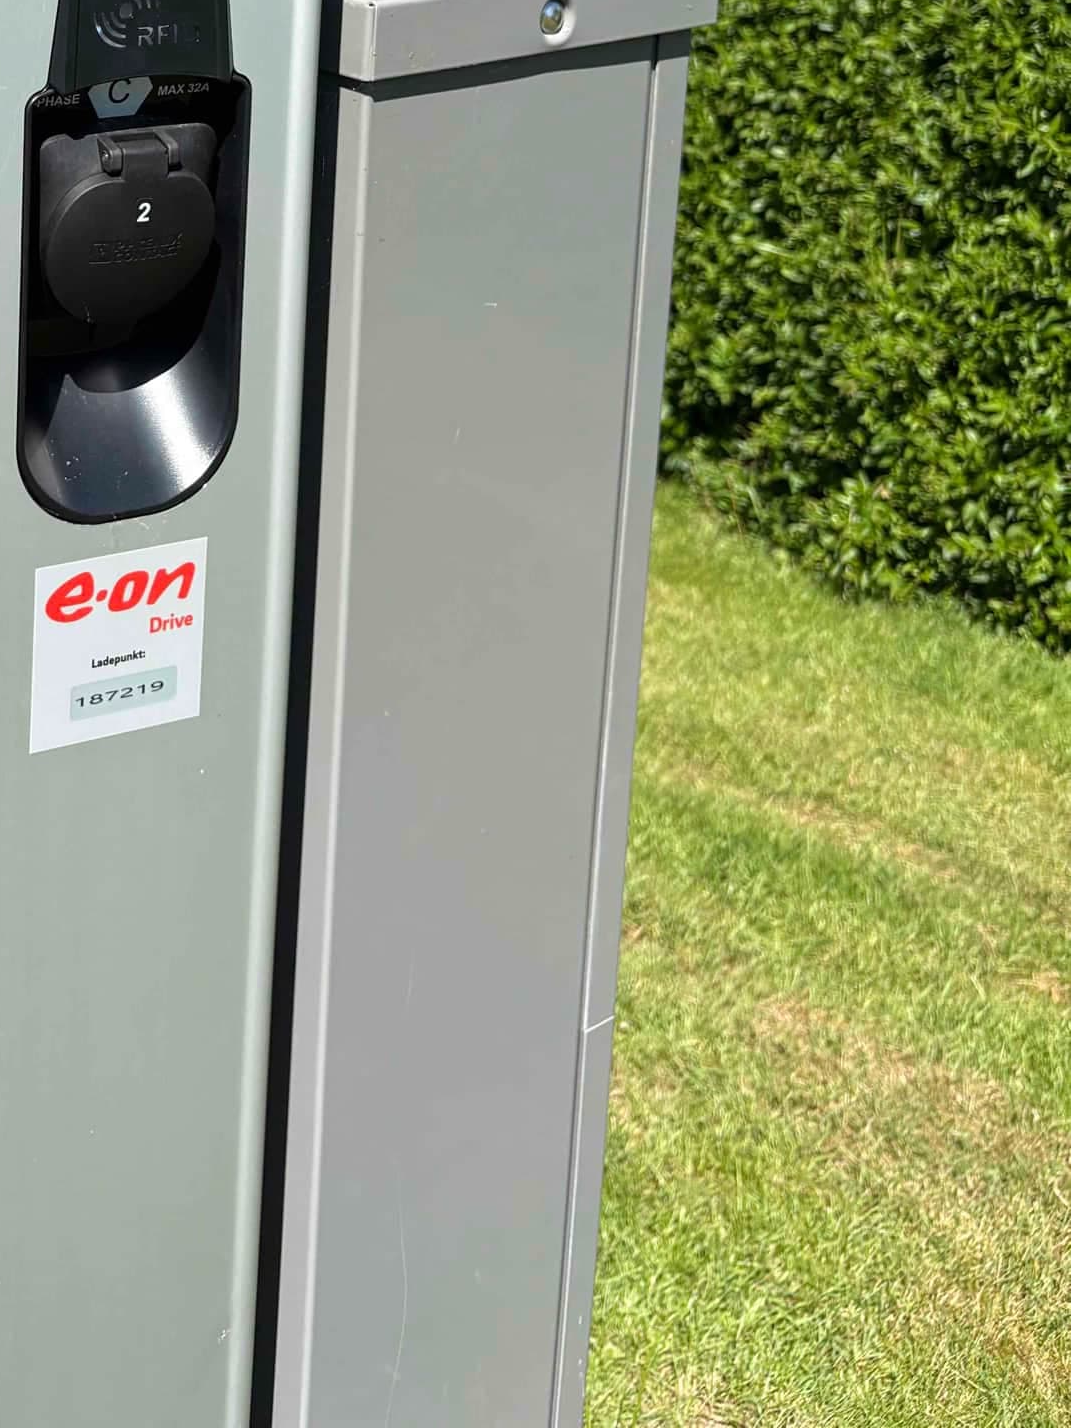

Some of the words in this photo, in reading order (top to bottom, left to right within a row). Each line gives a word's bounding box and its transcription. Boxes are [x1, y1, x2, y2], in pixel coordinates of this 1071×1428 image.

[157, 84, 185, 96] MAX
[188, 83, 209, 93] 32A
[136, 202, 151, 222] 2
[149, 613, 194, 634] Drive
[91, 650, 146, 669] Ladepunkt:
[75, 680, 165, 708] 187219
